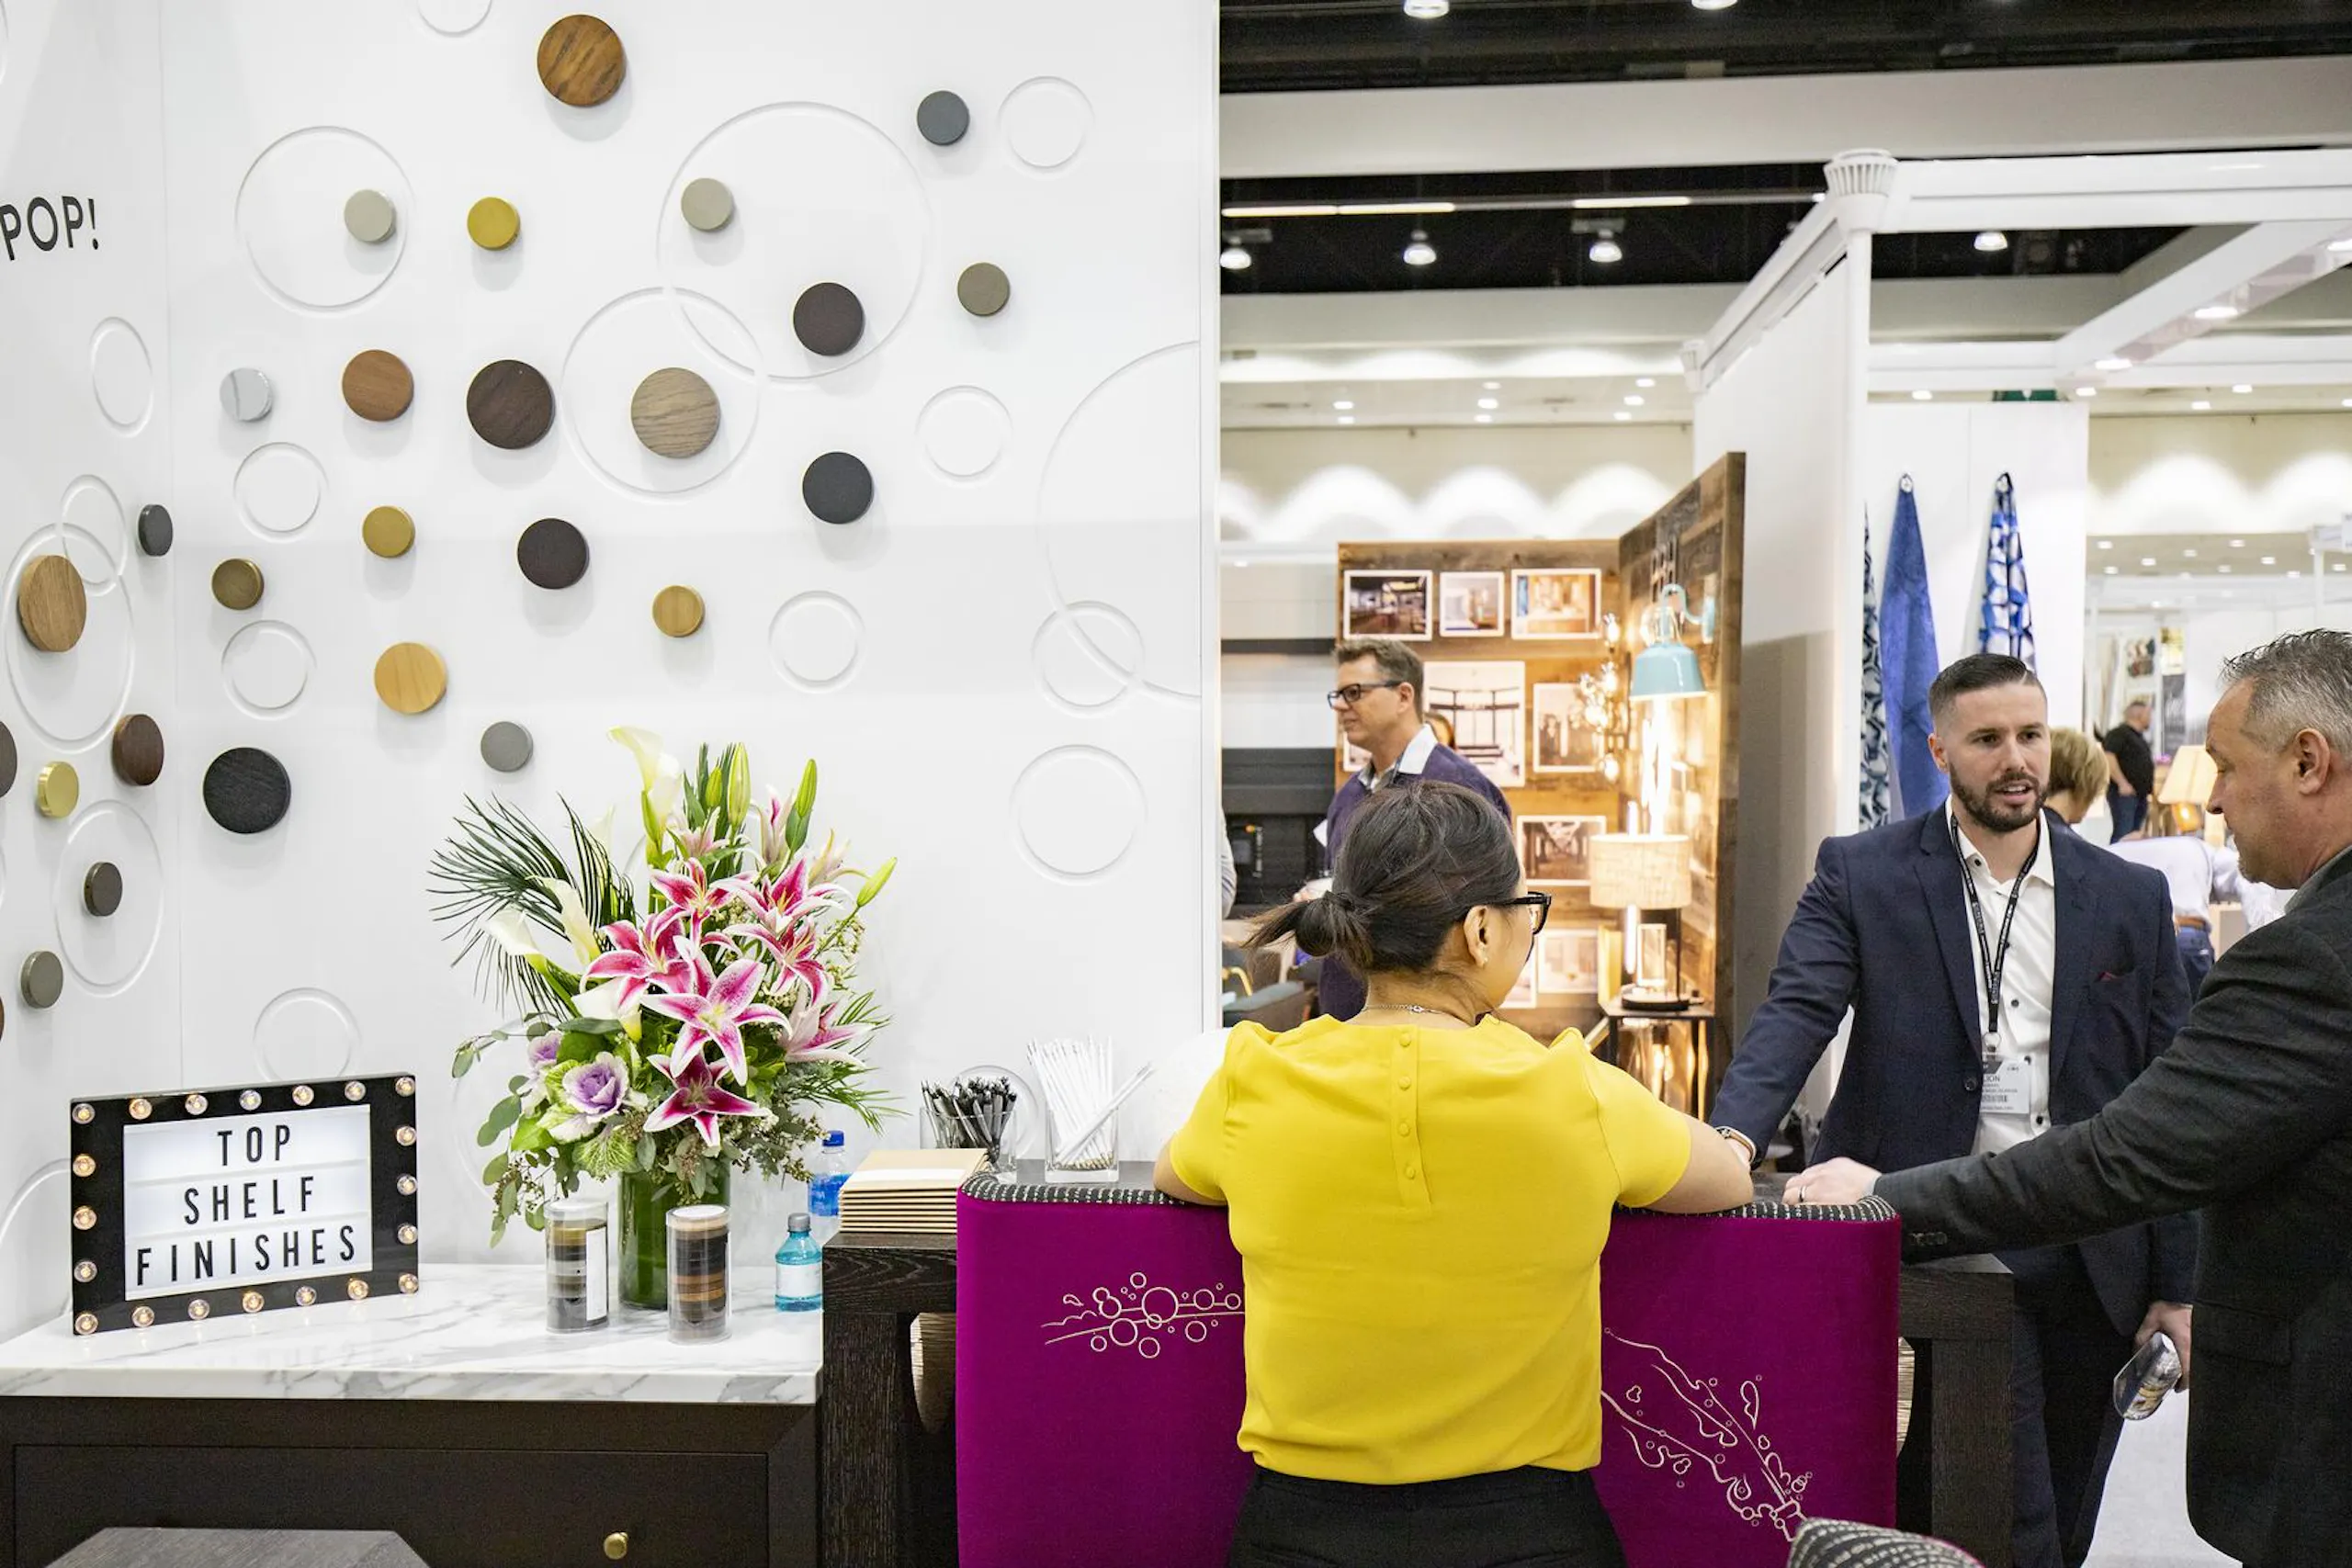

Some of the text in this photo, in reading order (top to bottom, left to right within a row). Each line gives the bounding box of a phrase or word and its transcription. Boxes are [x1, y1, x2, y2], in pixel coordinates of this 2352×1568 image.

[0, 196, 98, 261] POP!
[217, 1124, 290, 1167] TOP
[184, 1176, 314, 1225] SHELF
[136, 1224, 355, 1286] FINISHES
